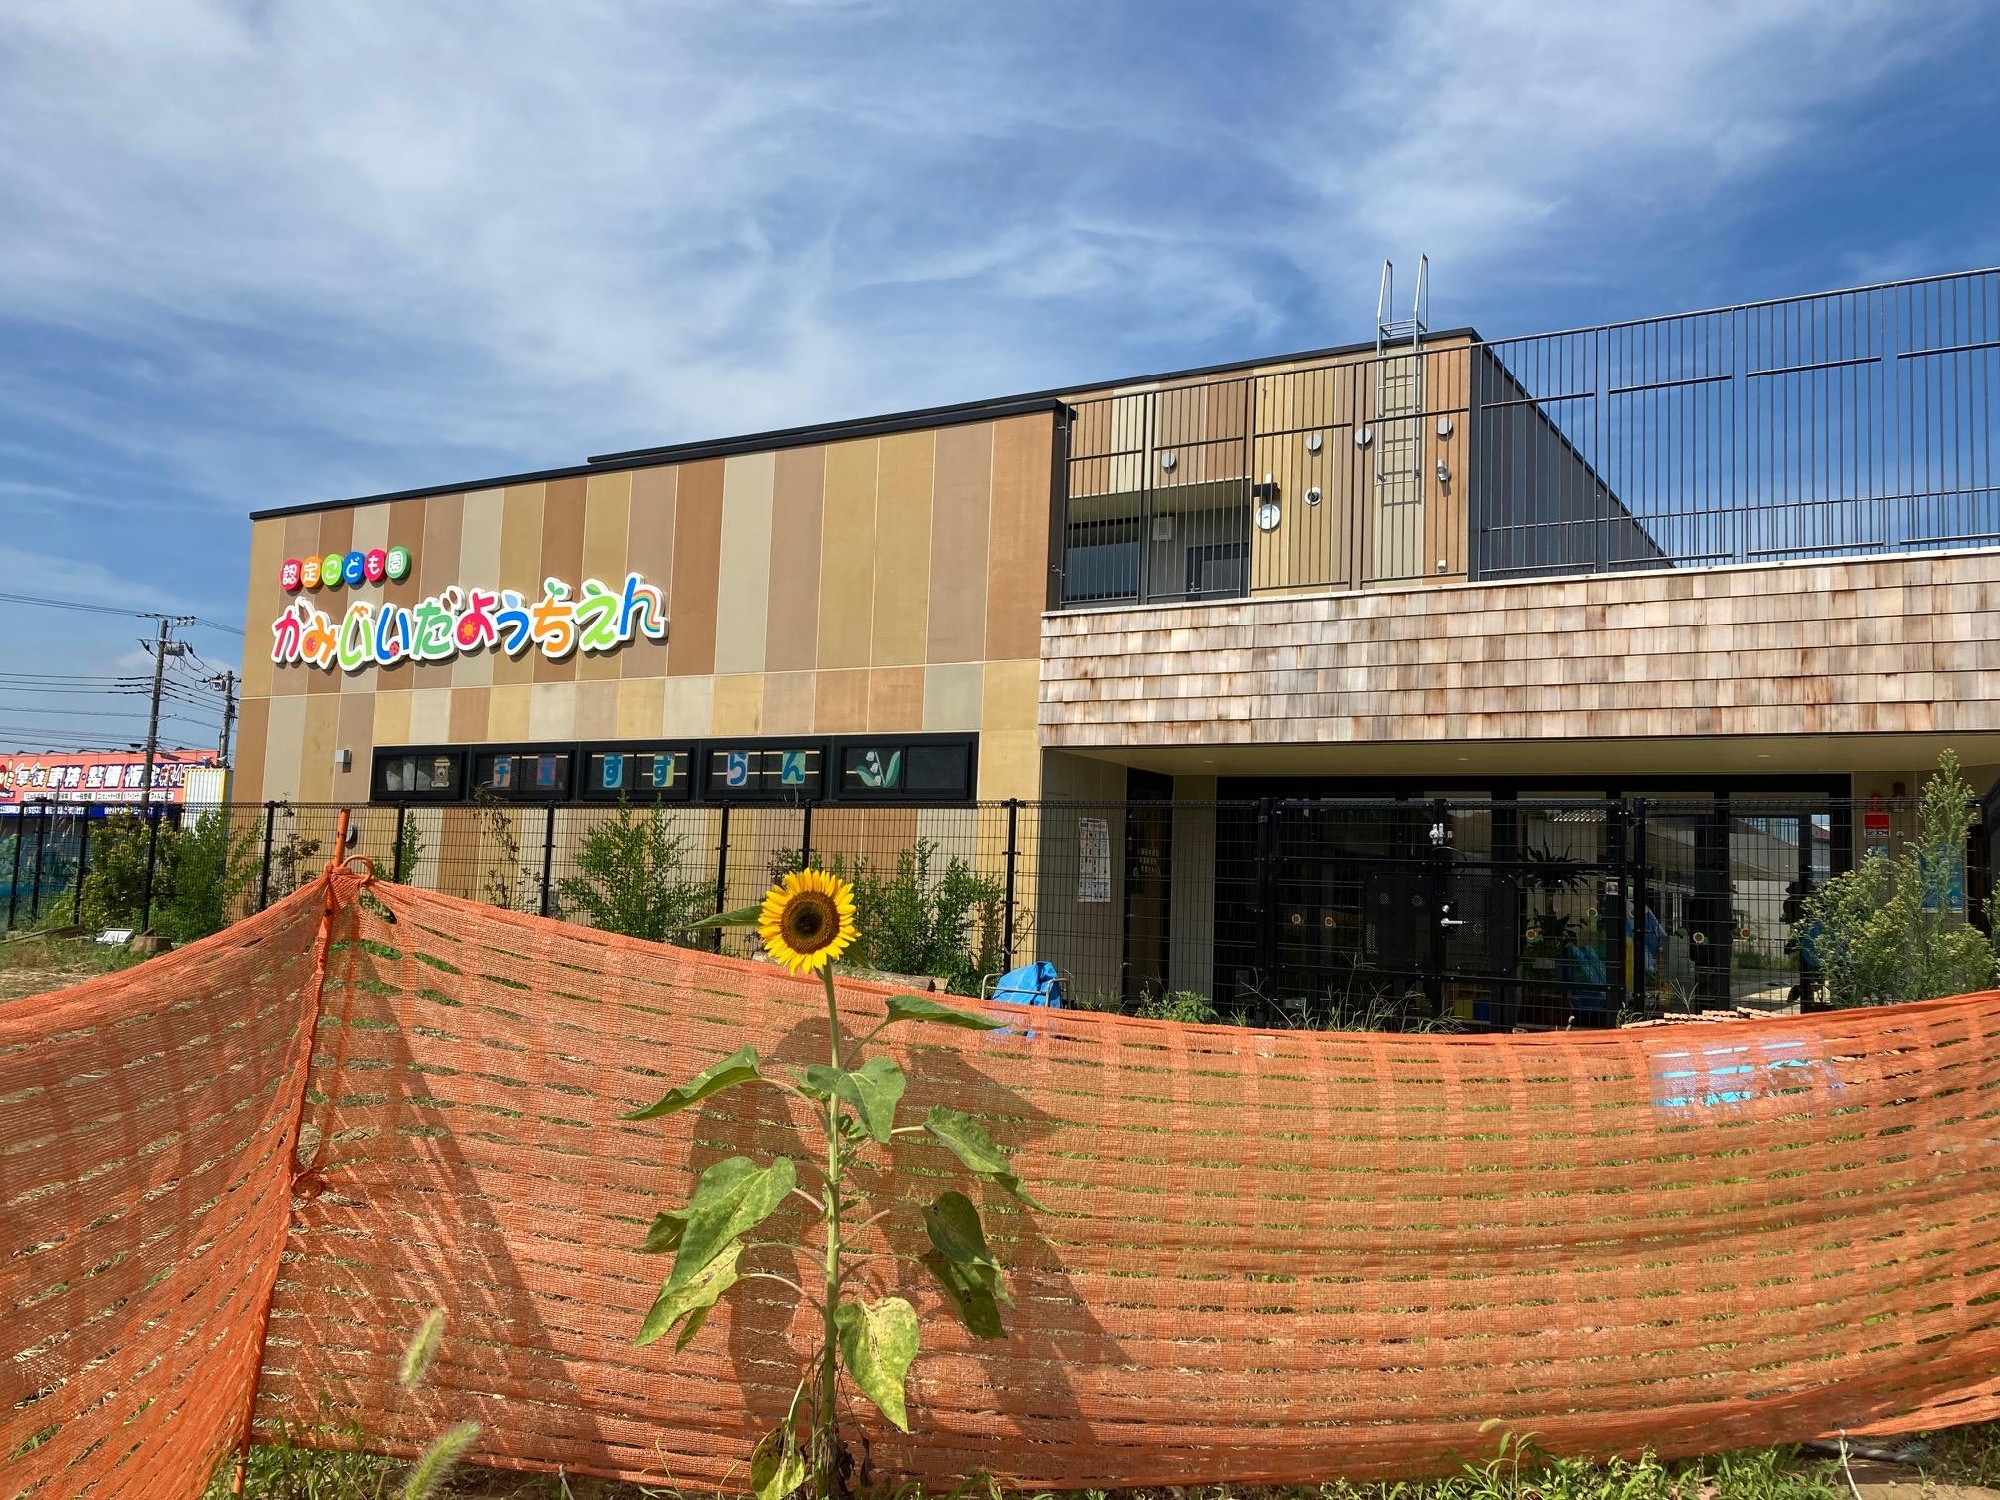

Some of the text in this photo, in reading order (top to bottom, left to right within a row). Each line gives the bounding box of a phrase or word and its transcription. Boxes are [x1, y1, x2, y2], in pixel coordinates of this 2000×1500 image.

[282, 551, 404, 585] 認定こども園
[274, 576, 662, 667] かみいいだようちえん
